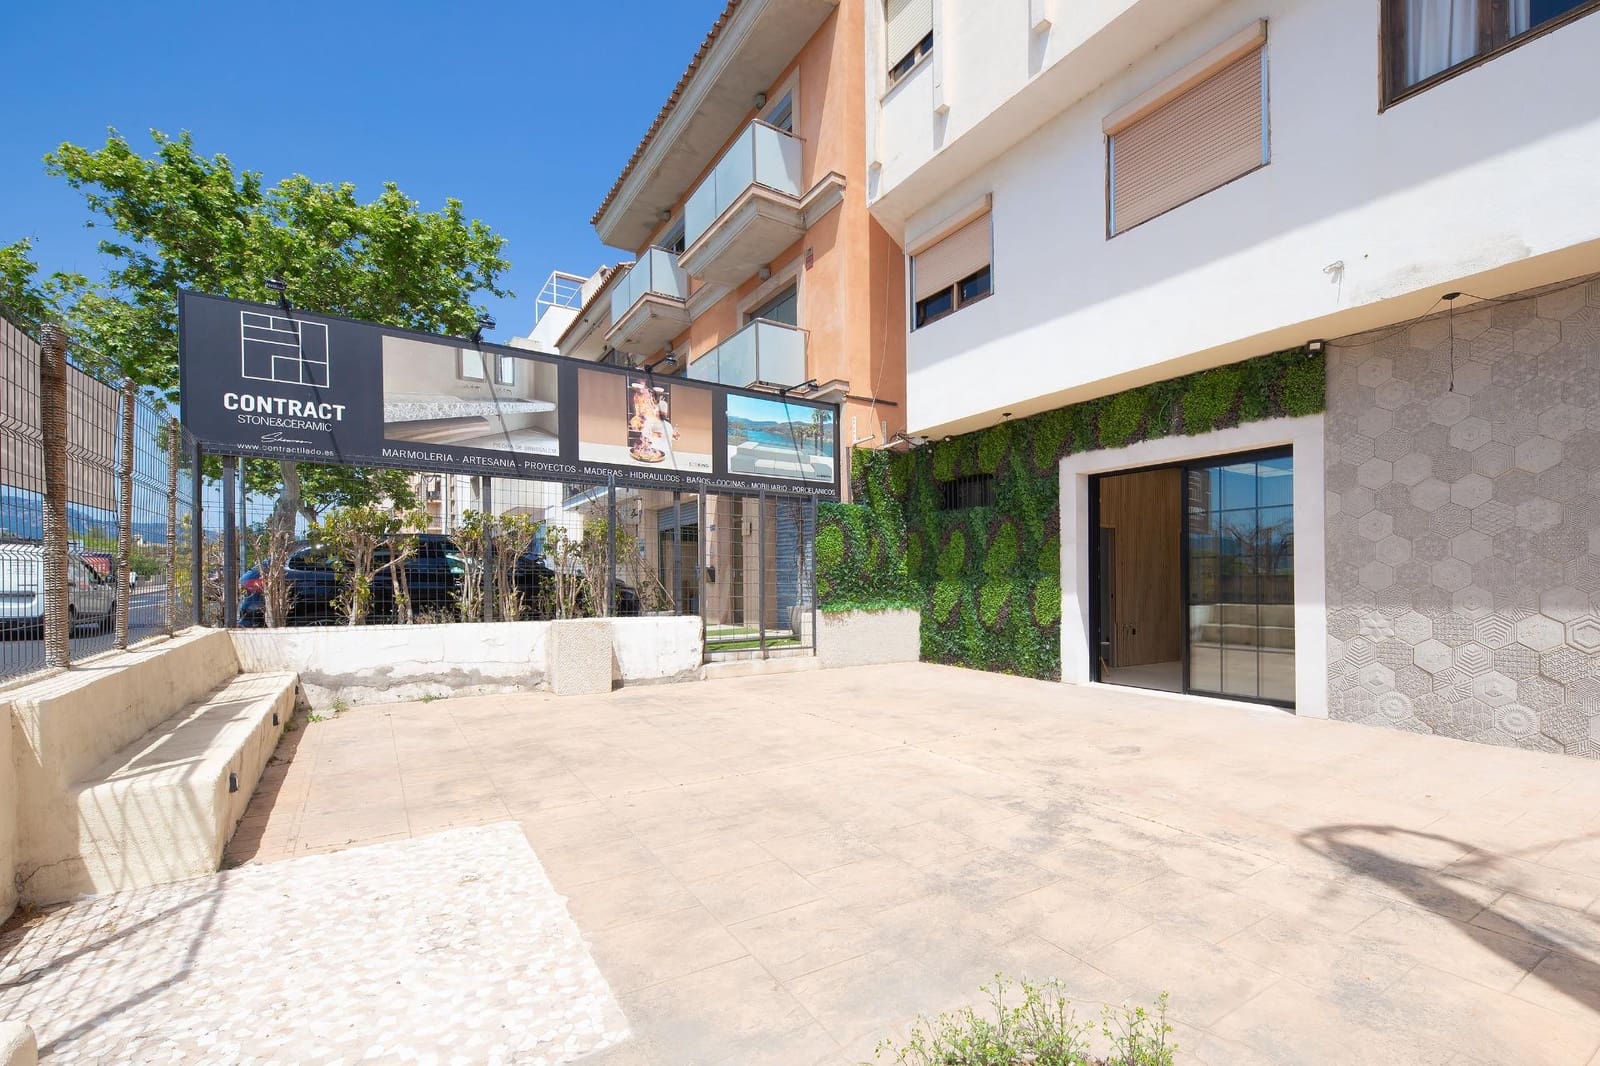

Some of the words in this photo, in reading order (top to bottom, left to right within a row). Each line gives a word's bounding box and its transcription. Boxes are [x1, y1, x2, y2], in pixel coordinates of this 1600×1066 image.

[223, 392, 346, 421] CONTRACT
[237, 414, 333, 432] STONE&CERAMIC
[236, 443, 335, 457] www.contractilado.es
[382, 448, 454, 463] MARMOLERIA
[462, 455, 516, 469] ARTESANIA
[524, 461, 577, 474] PROYECTOS
[583, 467, 624, 478] MADERAS
[630, 471, 681, 484] HIDRAULICOS
[716, 479, 746, 489] COCINAS
